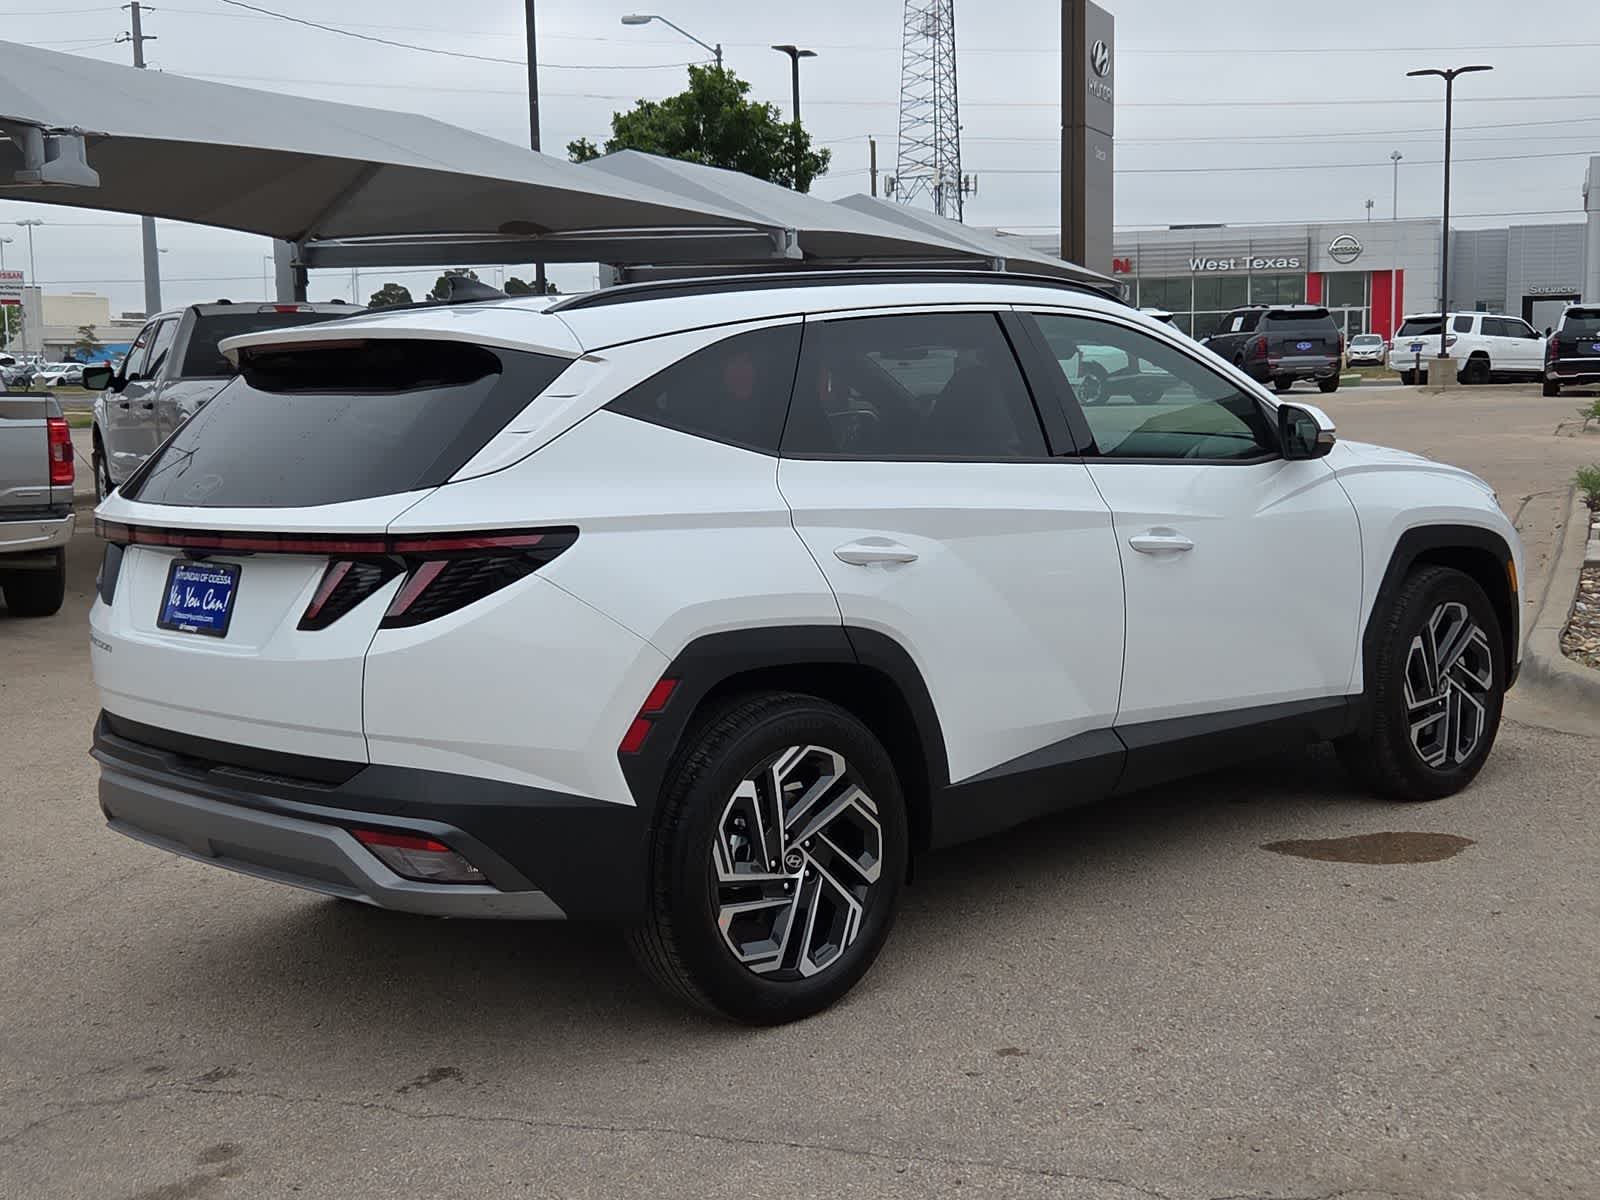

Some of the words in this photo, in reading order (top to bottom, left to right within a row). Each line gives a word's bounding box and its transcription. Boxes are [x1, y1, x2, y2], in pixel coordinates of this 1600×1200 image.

[1188, 257, 1235, 271] West
[1242, 255, 1300, 269] Texas
[1529, 285, 1577, 294] Service
[200, 573, 208, 582] OF
[208, 574, 231, 584] ODESSA
[168, 585, 181, 607] Yes
[184, 587, 200, 608] You
[202, 588, 231, 612] Can!
